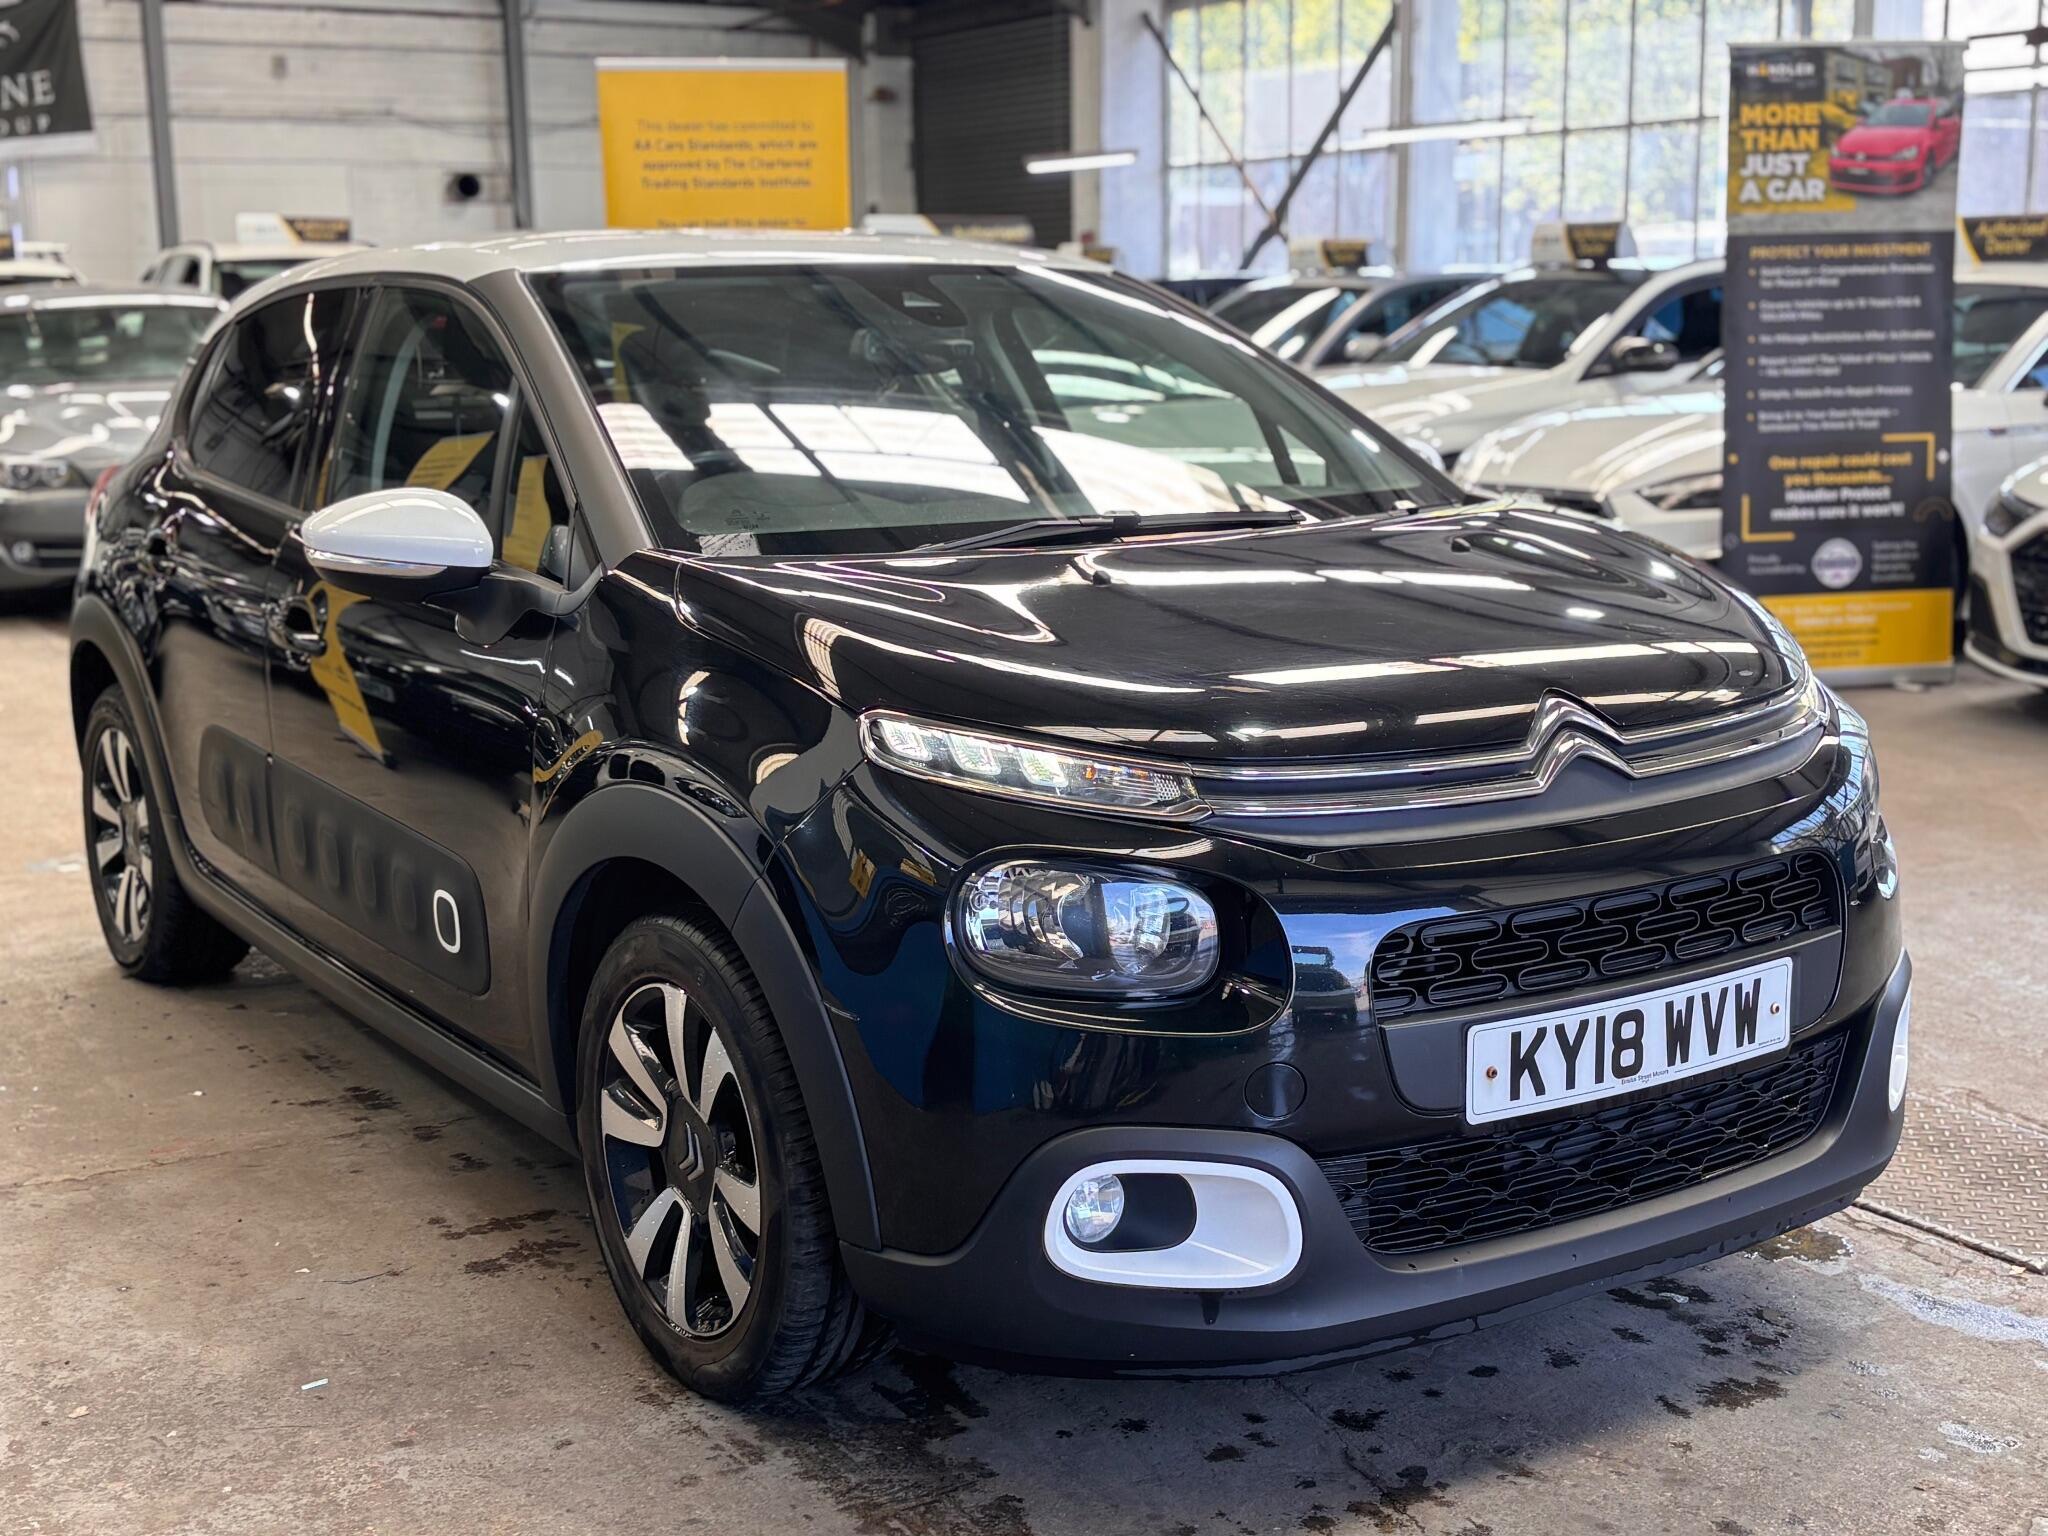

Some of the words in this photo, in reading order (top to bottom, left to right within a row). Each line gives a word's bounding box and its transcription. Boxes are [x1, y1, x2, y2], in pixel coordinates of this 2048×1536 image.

[1739, 103, 1822, 125] MORE
[1739, 129, 1820, 151] THAN
[1739, 153, 1810, 177] JUST
[1739, 180, 1760, 203] A
[1767, 179, 1825, 201] CAR
[1509, 1008, 1645, 1101] KY18
[1665, 977, 1762, 1067] WVW
